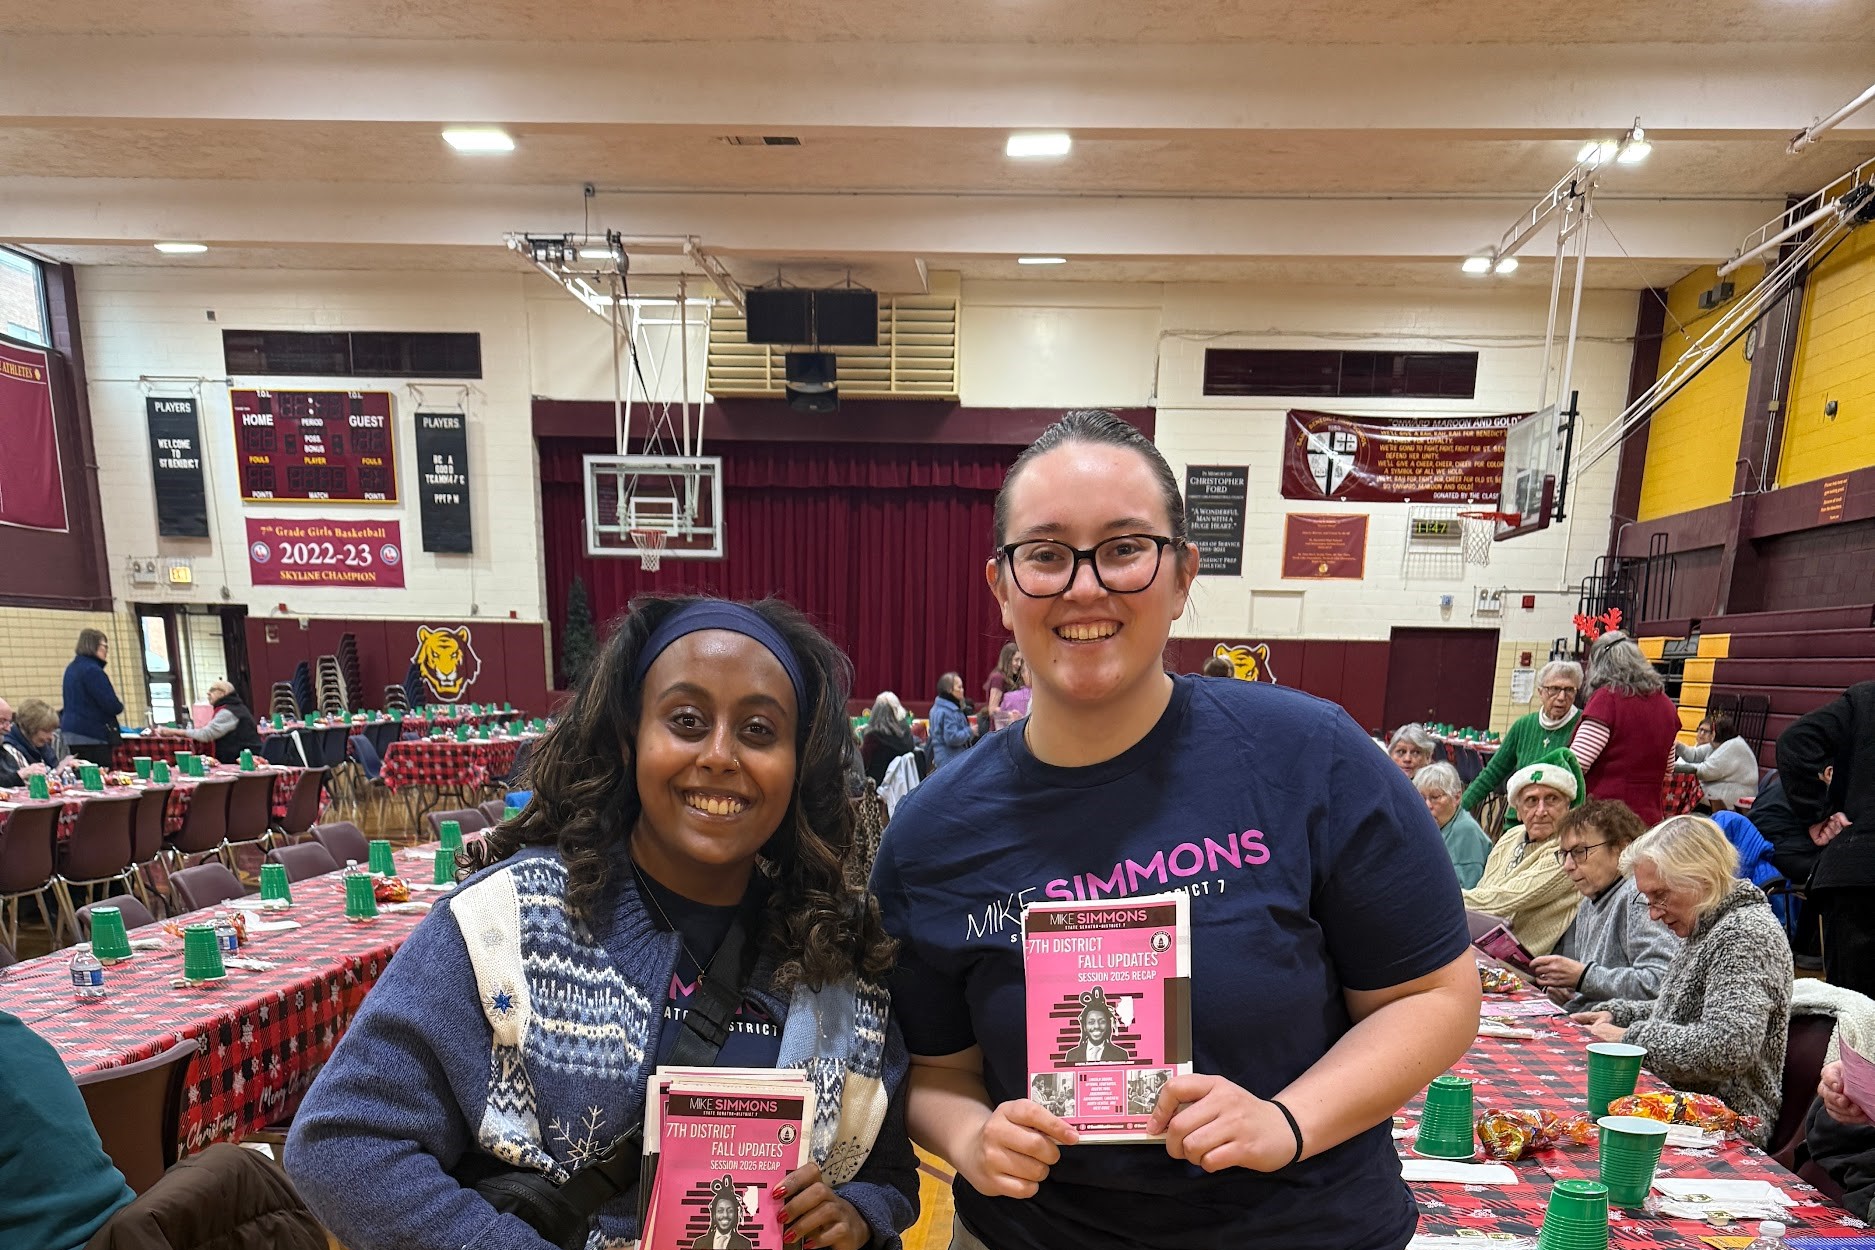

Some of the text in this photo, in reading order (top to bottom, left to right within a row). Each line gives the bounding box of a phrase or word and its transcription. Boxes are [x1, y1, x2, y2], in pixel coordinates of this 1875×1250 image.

[2, 361, 33, 379] ATHLETES
[154, 401, 191, 413] PLAYERS
[242, 413, 274, 426] HOME
[301, 418, 323, 427] PERIOD
[349, 415, 384, 428] GUEST
[422, 417, 461, 429] PLAYERS
[1432, 418, 1471, 427] MAROON
[1472, 417, 1492, 427] AND
[158, 439, 191, 450] WELCOME
[304, 444, 325, 454] BONUS
[171, 449, 181, 459] TO
[249, 455, 269, 464] FOULS
[447, 454, 454, 465] A
[1386, 452, 1408, 460] DEFEND
[304, 456, 327, 465] PLAYER
[362, 457, 382, 465] FOULS
[434, 464, 454, 474] GOOD
[252, 490, 274, 499] POINTS
[308, 491, 329, 499] MATCH
[1205, 485, 1228, 494] FORD
[1433, 491, 1459, 499] DONATED
[364, 492, 386, 500] POINTS
[275, 526, 305, 537] Grade
[307, 526, 333, 537] Girls
[335, 527, 386, 538] Basketball
[279, 541, 373, 567] 2022-23
[279, 569, 377, 582] SKYLINE CHAMPION
[1044, 829, 1271, 902] SIMMONS
[1050, 909, 1149, 926] MIKE SIMMONS
[1029, 938, 1050, 955] 7TH
[1053, 936, 1104, 954] DISTRICT
[1077, 950, 1159, 969] FALL UPDATES
[1077, 968, 1157, 983] SESSION 2025 RECAP
[728, 1020, 779, 1038] STRICT
[689, 1097, 778, 1113] MIKE SIMMONS
[666, 1122, 737, 1140] 7TH DISTRICT
[711, 1141, 783, 1158] FALL UPDATES
[710, 1159, 781, 1171] SESSION 2025 RECAP
